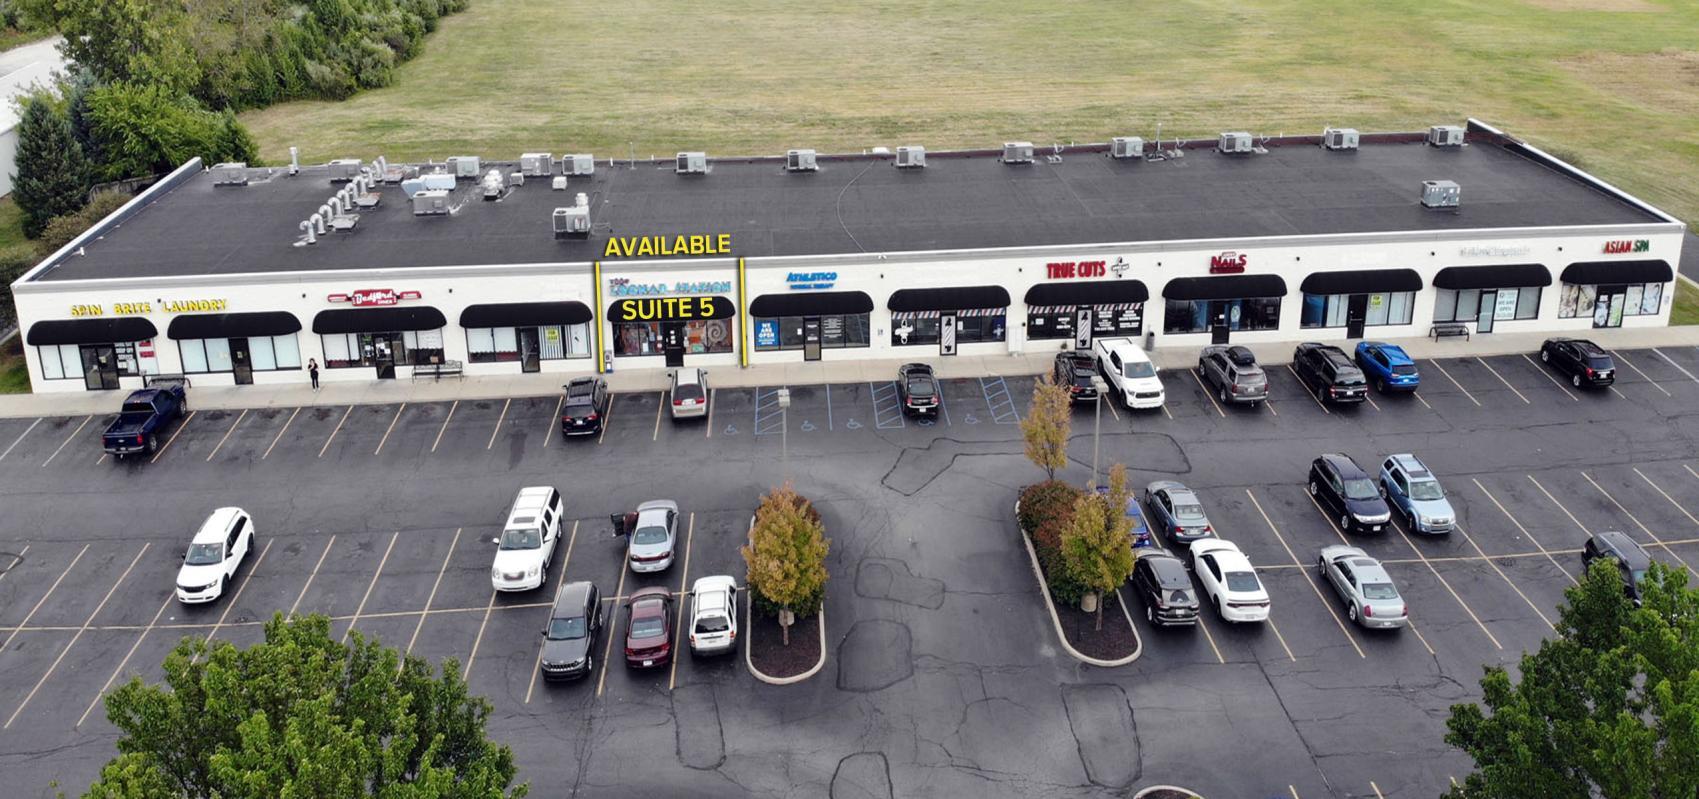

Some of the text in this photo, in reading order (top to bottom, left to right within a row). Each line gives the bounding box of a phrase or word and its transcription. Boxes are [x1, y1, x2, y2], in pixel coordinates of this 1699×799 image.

[1603, 239, 1649, 254] ASIAN SPA
[1210, 254, 1247, 268] NAILS
[1046, 261, 1105, 279] TRUE CUTS
[71, 299, 227, 317] SPIN BRITE LAUNDRY
